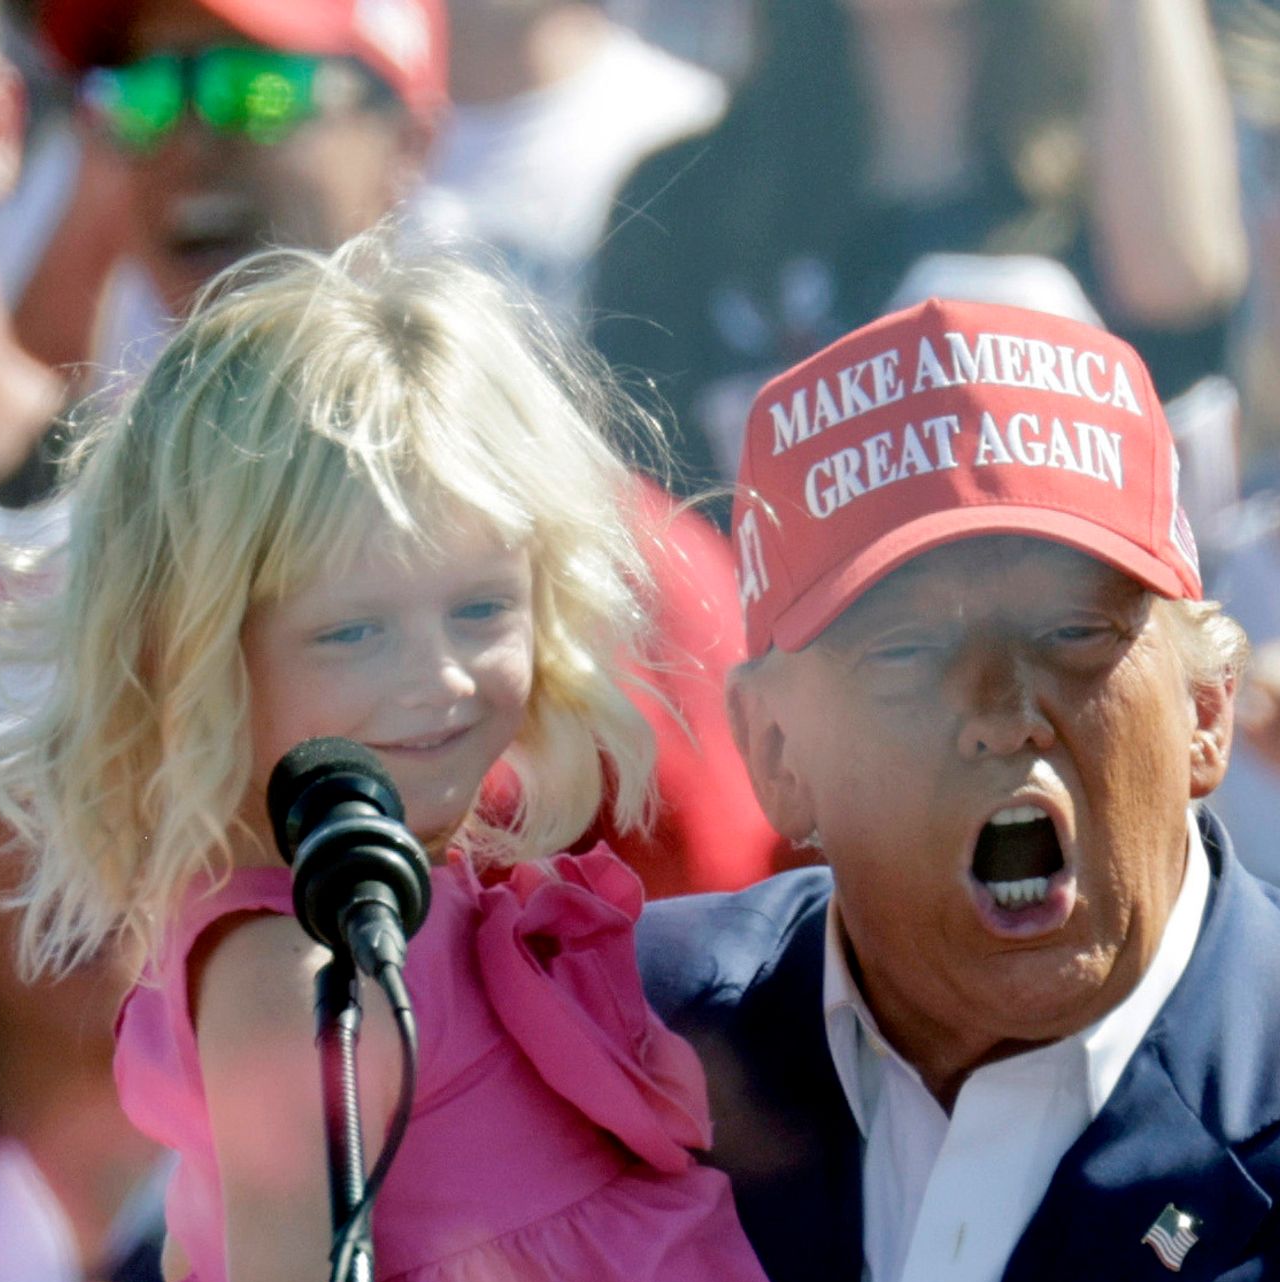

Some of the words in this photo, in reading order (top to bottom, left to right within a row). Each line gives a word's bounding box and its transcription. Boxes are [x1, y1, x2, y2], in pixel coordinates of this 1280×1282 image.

[770, 348, 905, 456] MAKE
[912, 331, 1143, 417] AMERICA
[805, 414, 960, 519] GREAT
[976, 411, 1123, 490] AGAIN
